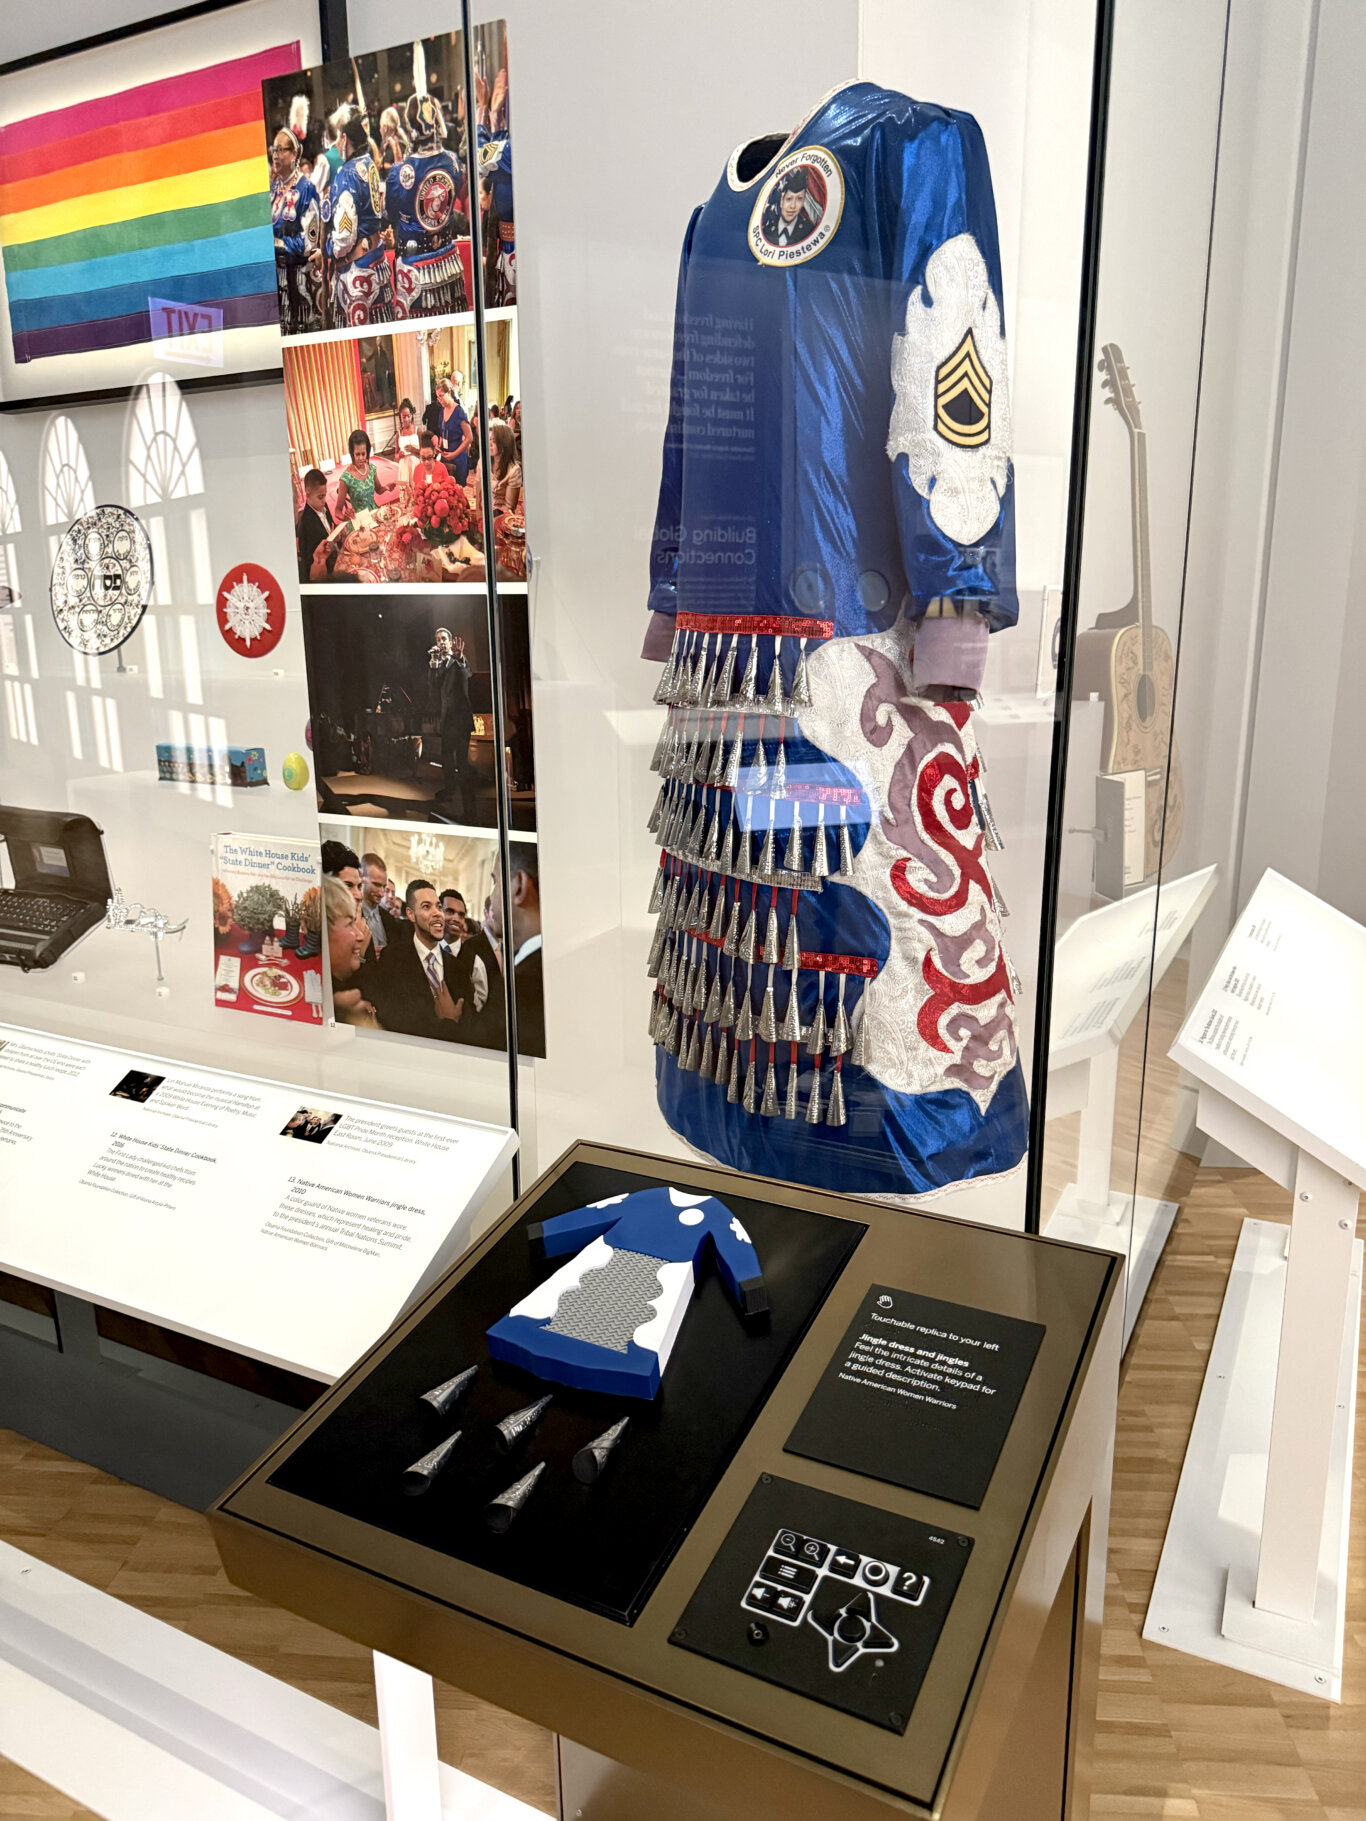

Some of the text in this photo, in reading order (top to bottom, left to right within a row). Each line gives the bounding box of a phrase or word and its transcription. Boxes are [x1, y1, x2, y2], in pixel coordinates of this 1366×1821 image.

[776, 153, 833, 178] Never Forgotten
[759, 244, 775, 259] Lori
[778, 231, 825, 260] Piestewa
[224, 845, 238, 854] The
[240, 846, 263, 857] White
[264, 850, 288, 860] House
[276, 862, 316, 875] Cookbook
[872, 1313, 999, 1351] Touchable replica to your left
[854, 1342, 873, 1351] Feel
[875, 1347, 889, 1356] the
[891, 1352, 929, 1367] intricate
[931, 1363, 962, 1375] details
[860, 1334, 969, 1367] Jingle dress and jingles
[849, 1351, 996, 1394] jingle dress. Activate keypad for
[851, 1364, 885, 1376] guided
[886, 1372, 939, 1391] description.
[839, 1373, 956, 1409] Native American Women Warriors
[928, 1535, 944, 1545] 4542
